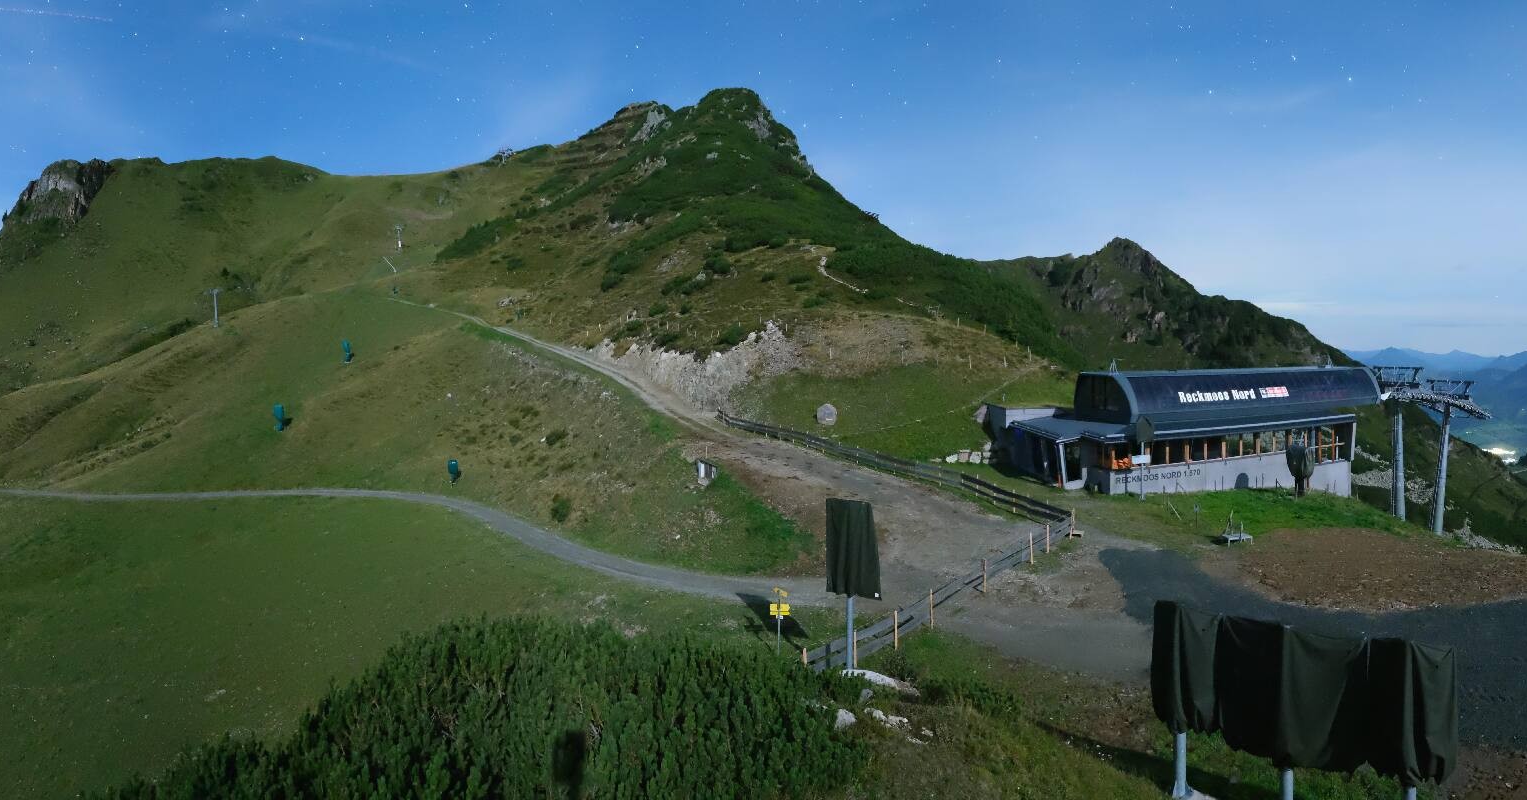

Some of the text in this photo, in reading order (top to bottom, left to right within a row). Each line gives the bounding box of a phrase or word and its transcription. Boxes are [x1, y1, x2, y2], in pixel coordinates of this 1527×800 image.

[1178, 390, 1230, 403] Reckmoos
[1230, 388, 1256, 400] Nord
[1161, 471, 1182, 480] NORD
